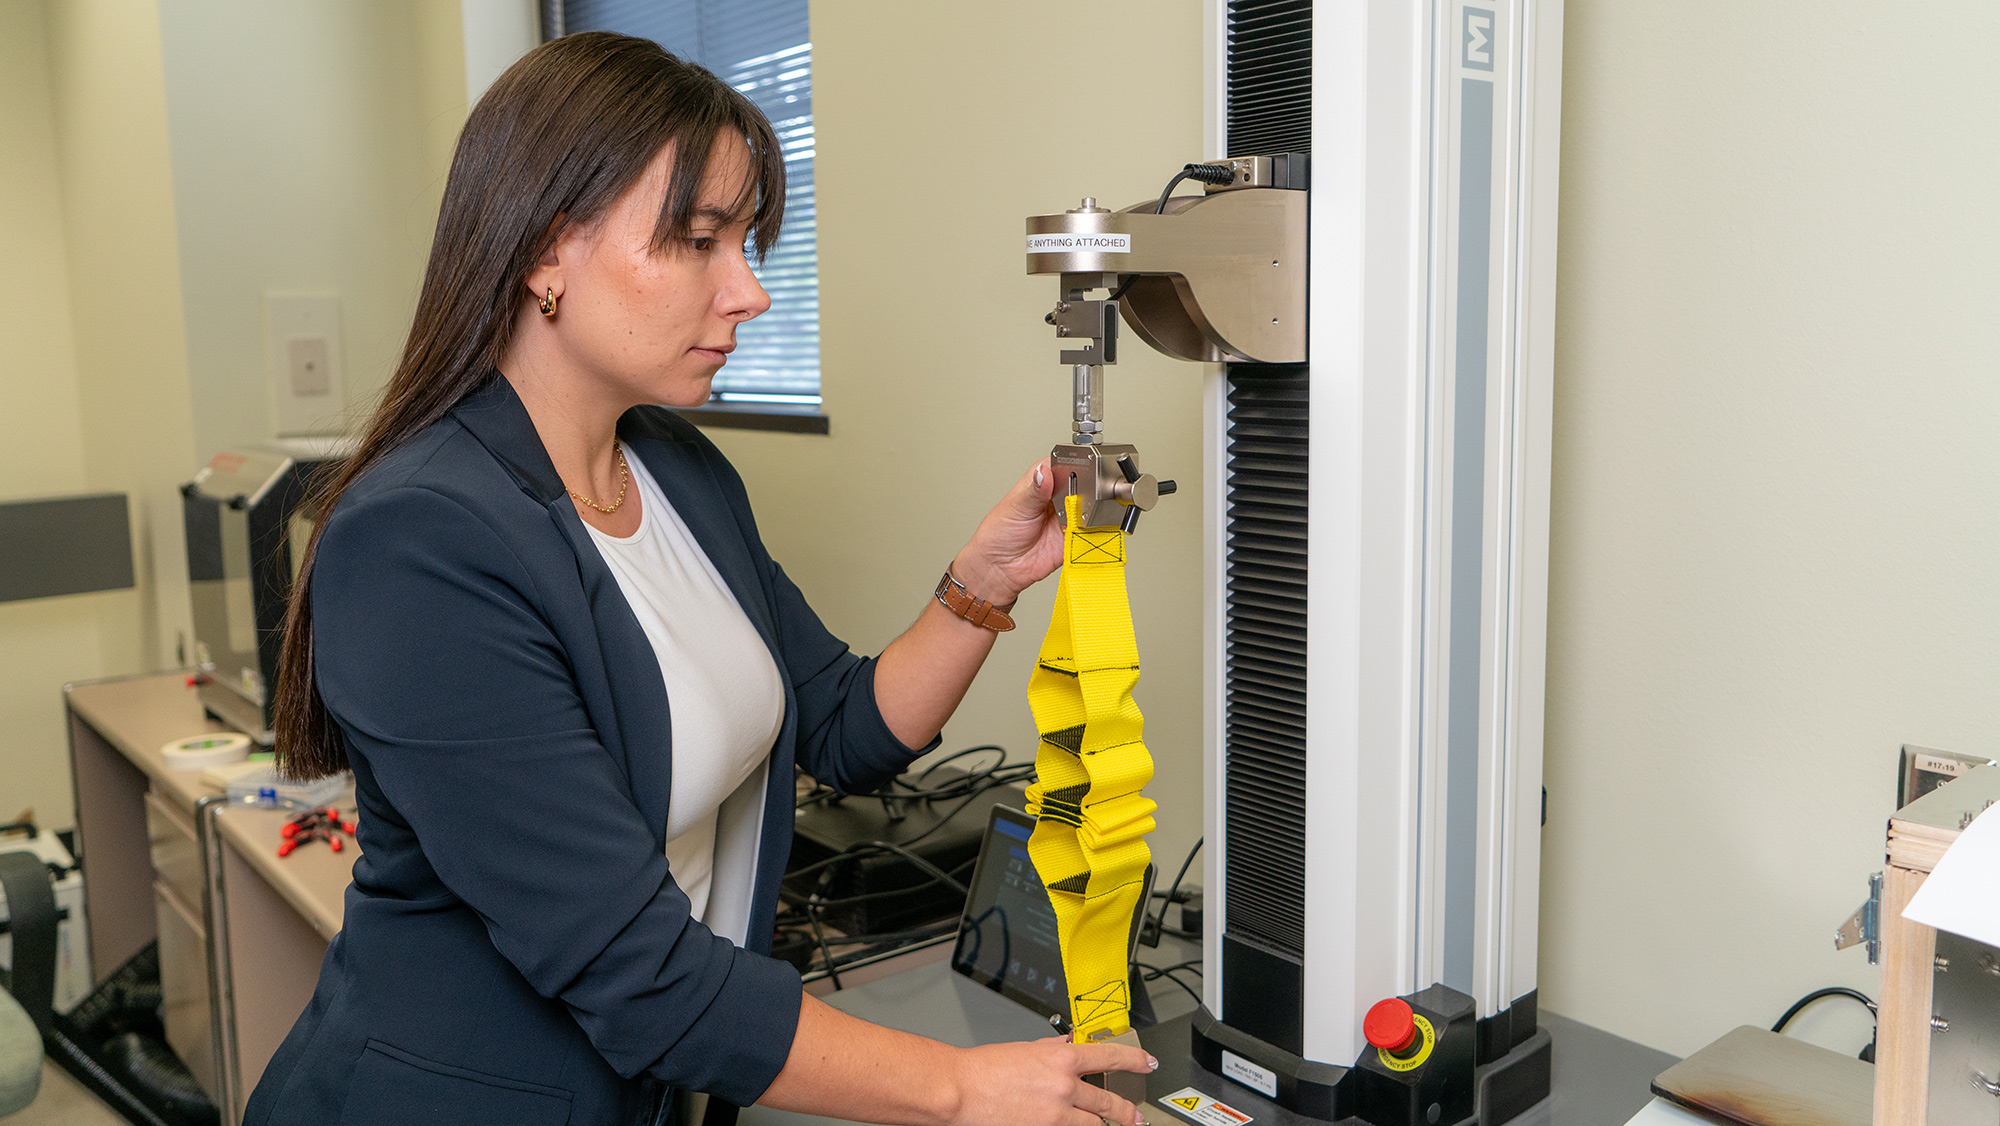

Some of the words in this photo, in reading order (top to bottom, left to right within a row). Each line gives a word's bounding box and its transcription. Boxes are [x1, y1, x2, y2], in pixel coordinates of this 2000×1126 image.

[1034, 238, 1073, 248] ANYTHING
[1075, 237, 1126, 248] ATTACHED
[1425, 1027, 1433, 1044] STOP
[1401, 1060, 1417, 1069] STOP
